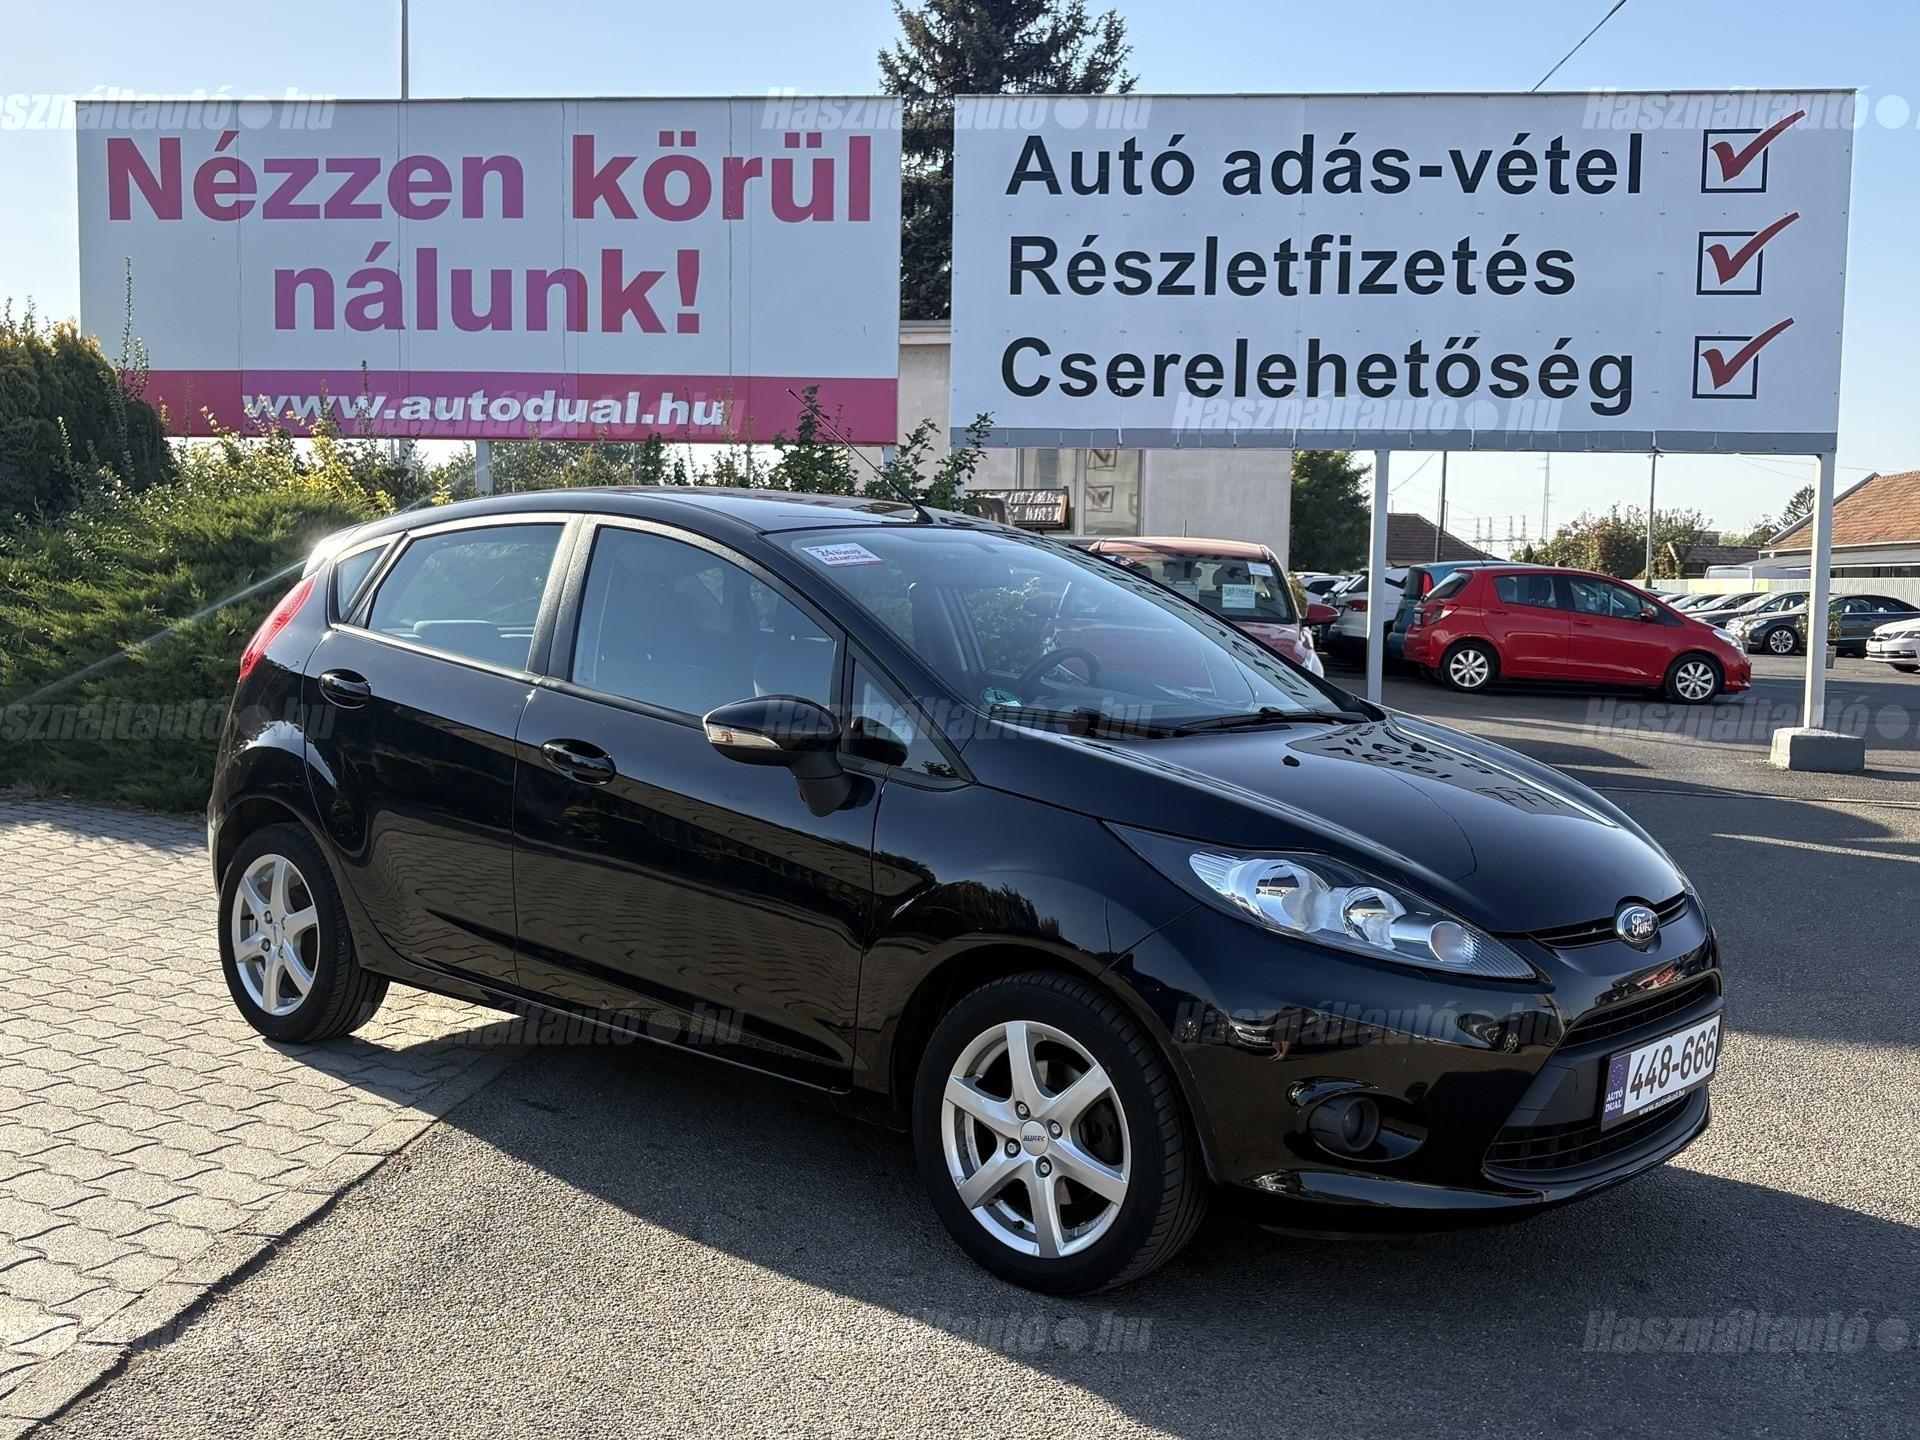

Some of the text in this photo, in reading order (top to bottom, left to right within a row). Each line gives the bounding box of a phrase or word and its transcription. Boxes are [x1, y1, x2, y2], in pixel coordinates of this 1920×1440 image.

[106, 130, 872, 223] Nézzen körül
[1004, 132, 1643, 197] Autó adás-vétel
[273, 241, 701, 334] nálunk!
[1009, 232, 1576, 296] Részletfizetés
[242, 390, 724, 426] www.autodual.hu
[1000, 335, 1634, 416] Cserelehetőség
[1629, 1024, 1717, 1101] 448-666
[1604, 1100, 1622, 1113] DUAL
